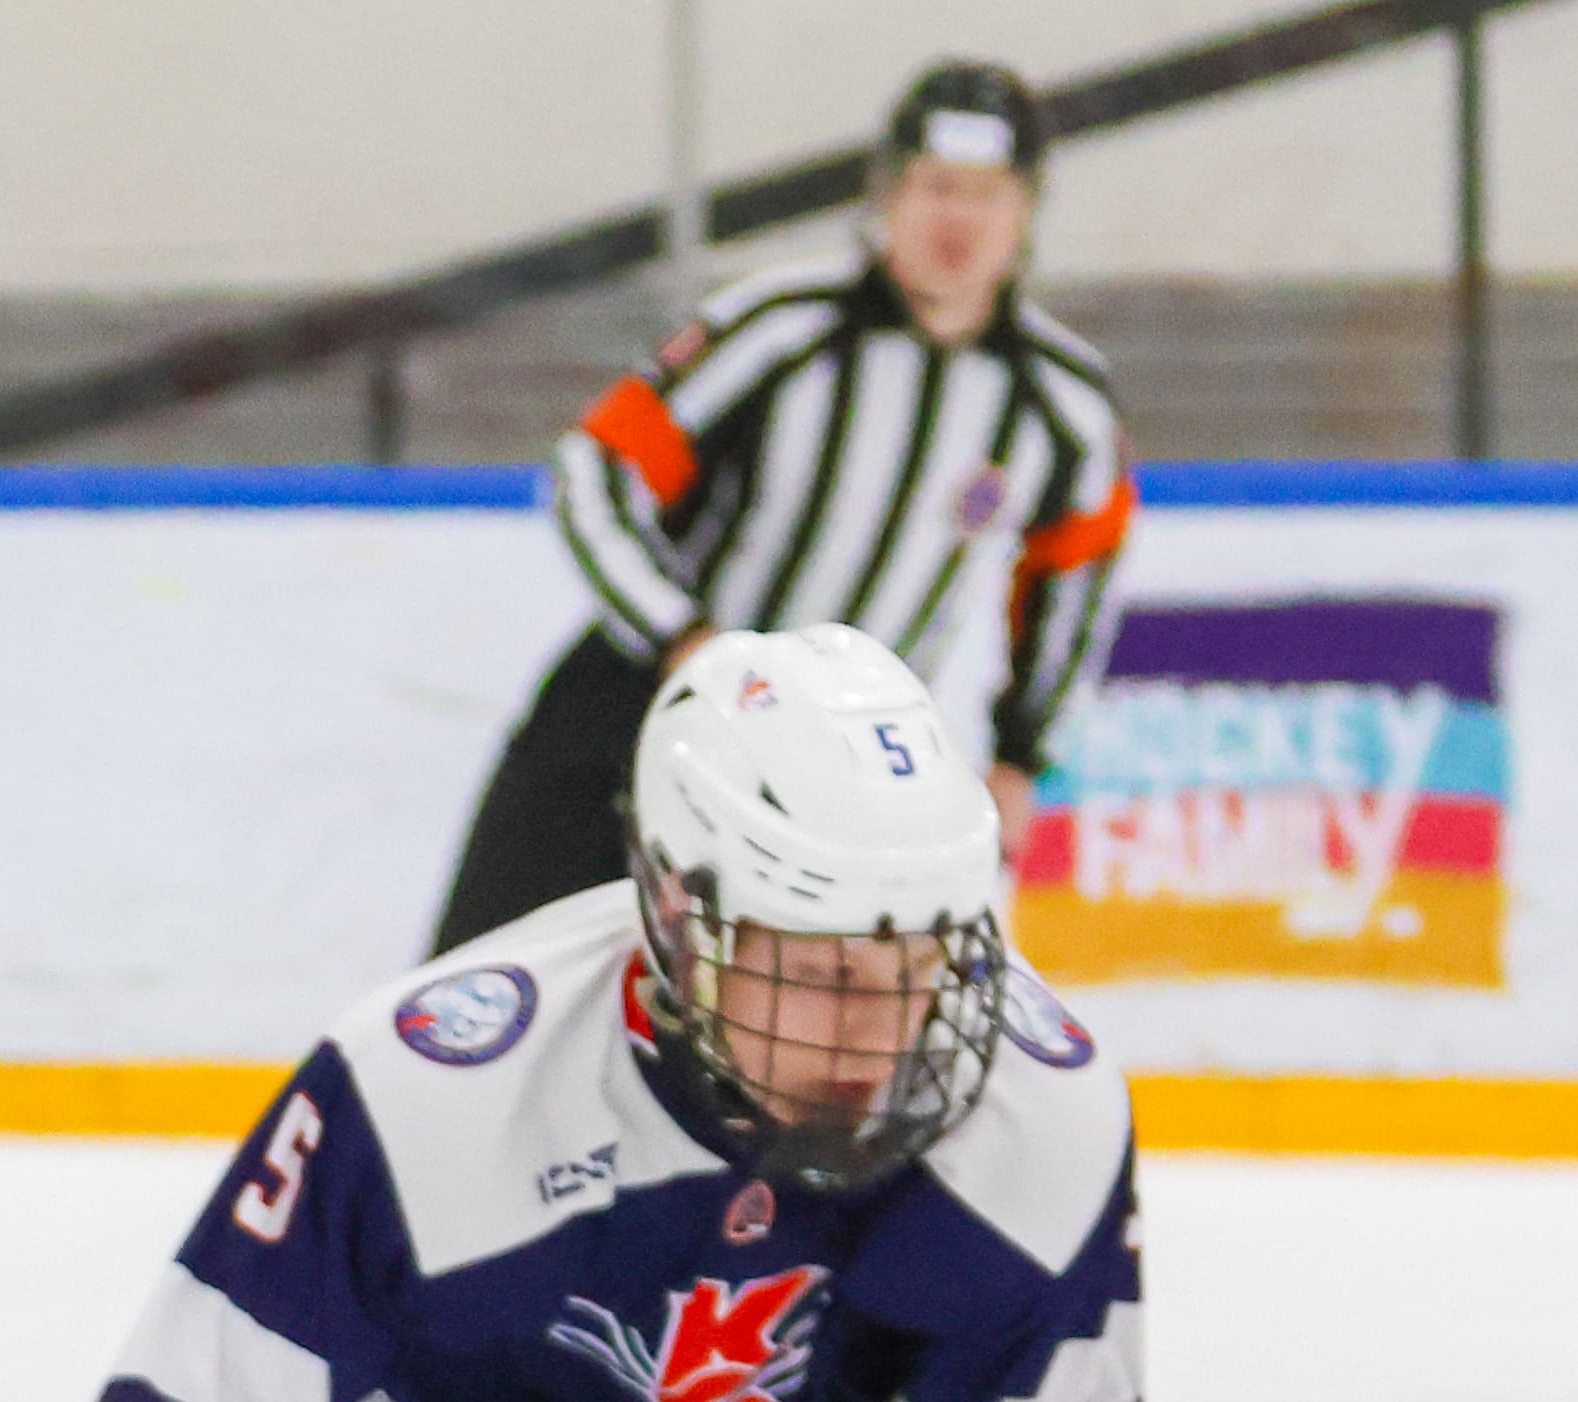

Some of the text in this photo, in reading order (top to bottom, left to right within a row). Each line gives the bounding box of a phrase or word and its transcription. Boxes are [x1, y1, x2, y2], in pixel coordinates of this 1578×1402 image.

[873, 722, 916, 776] 5
[1053, 678, 1448, 798] HOCKEY
[232, 1089, 324, 1242] 5
